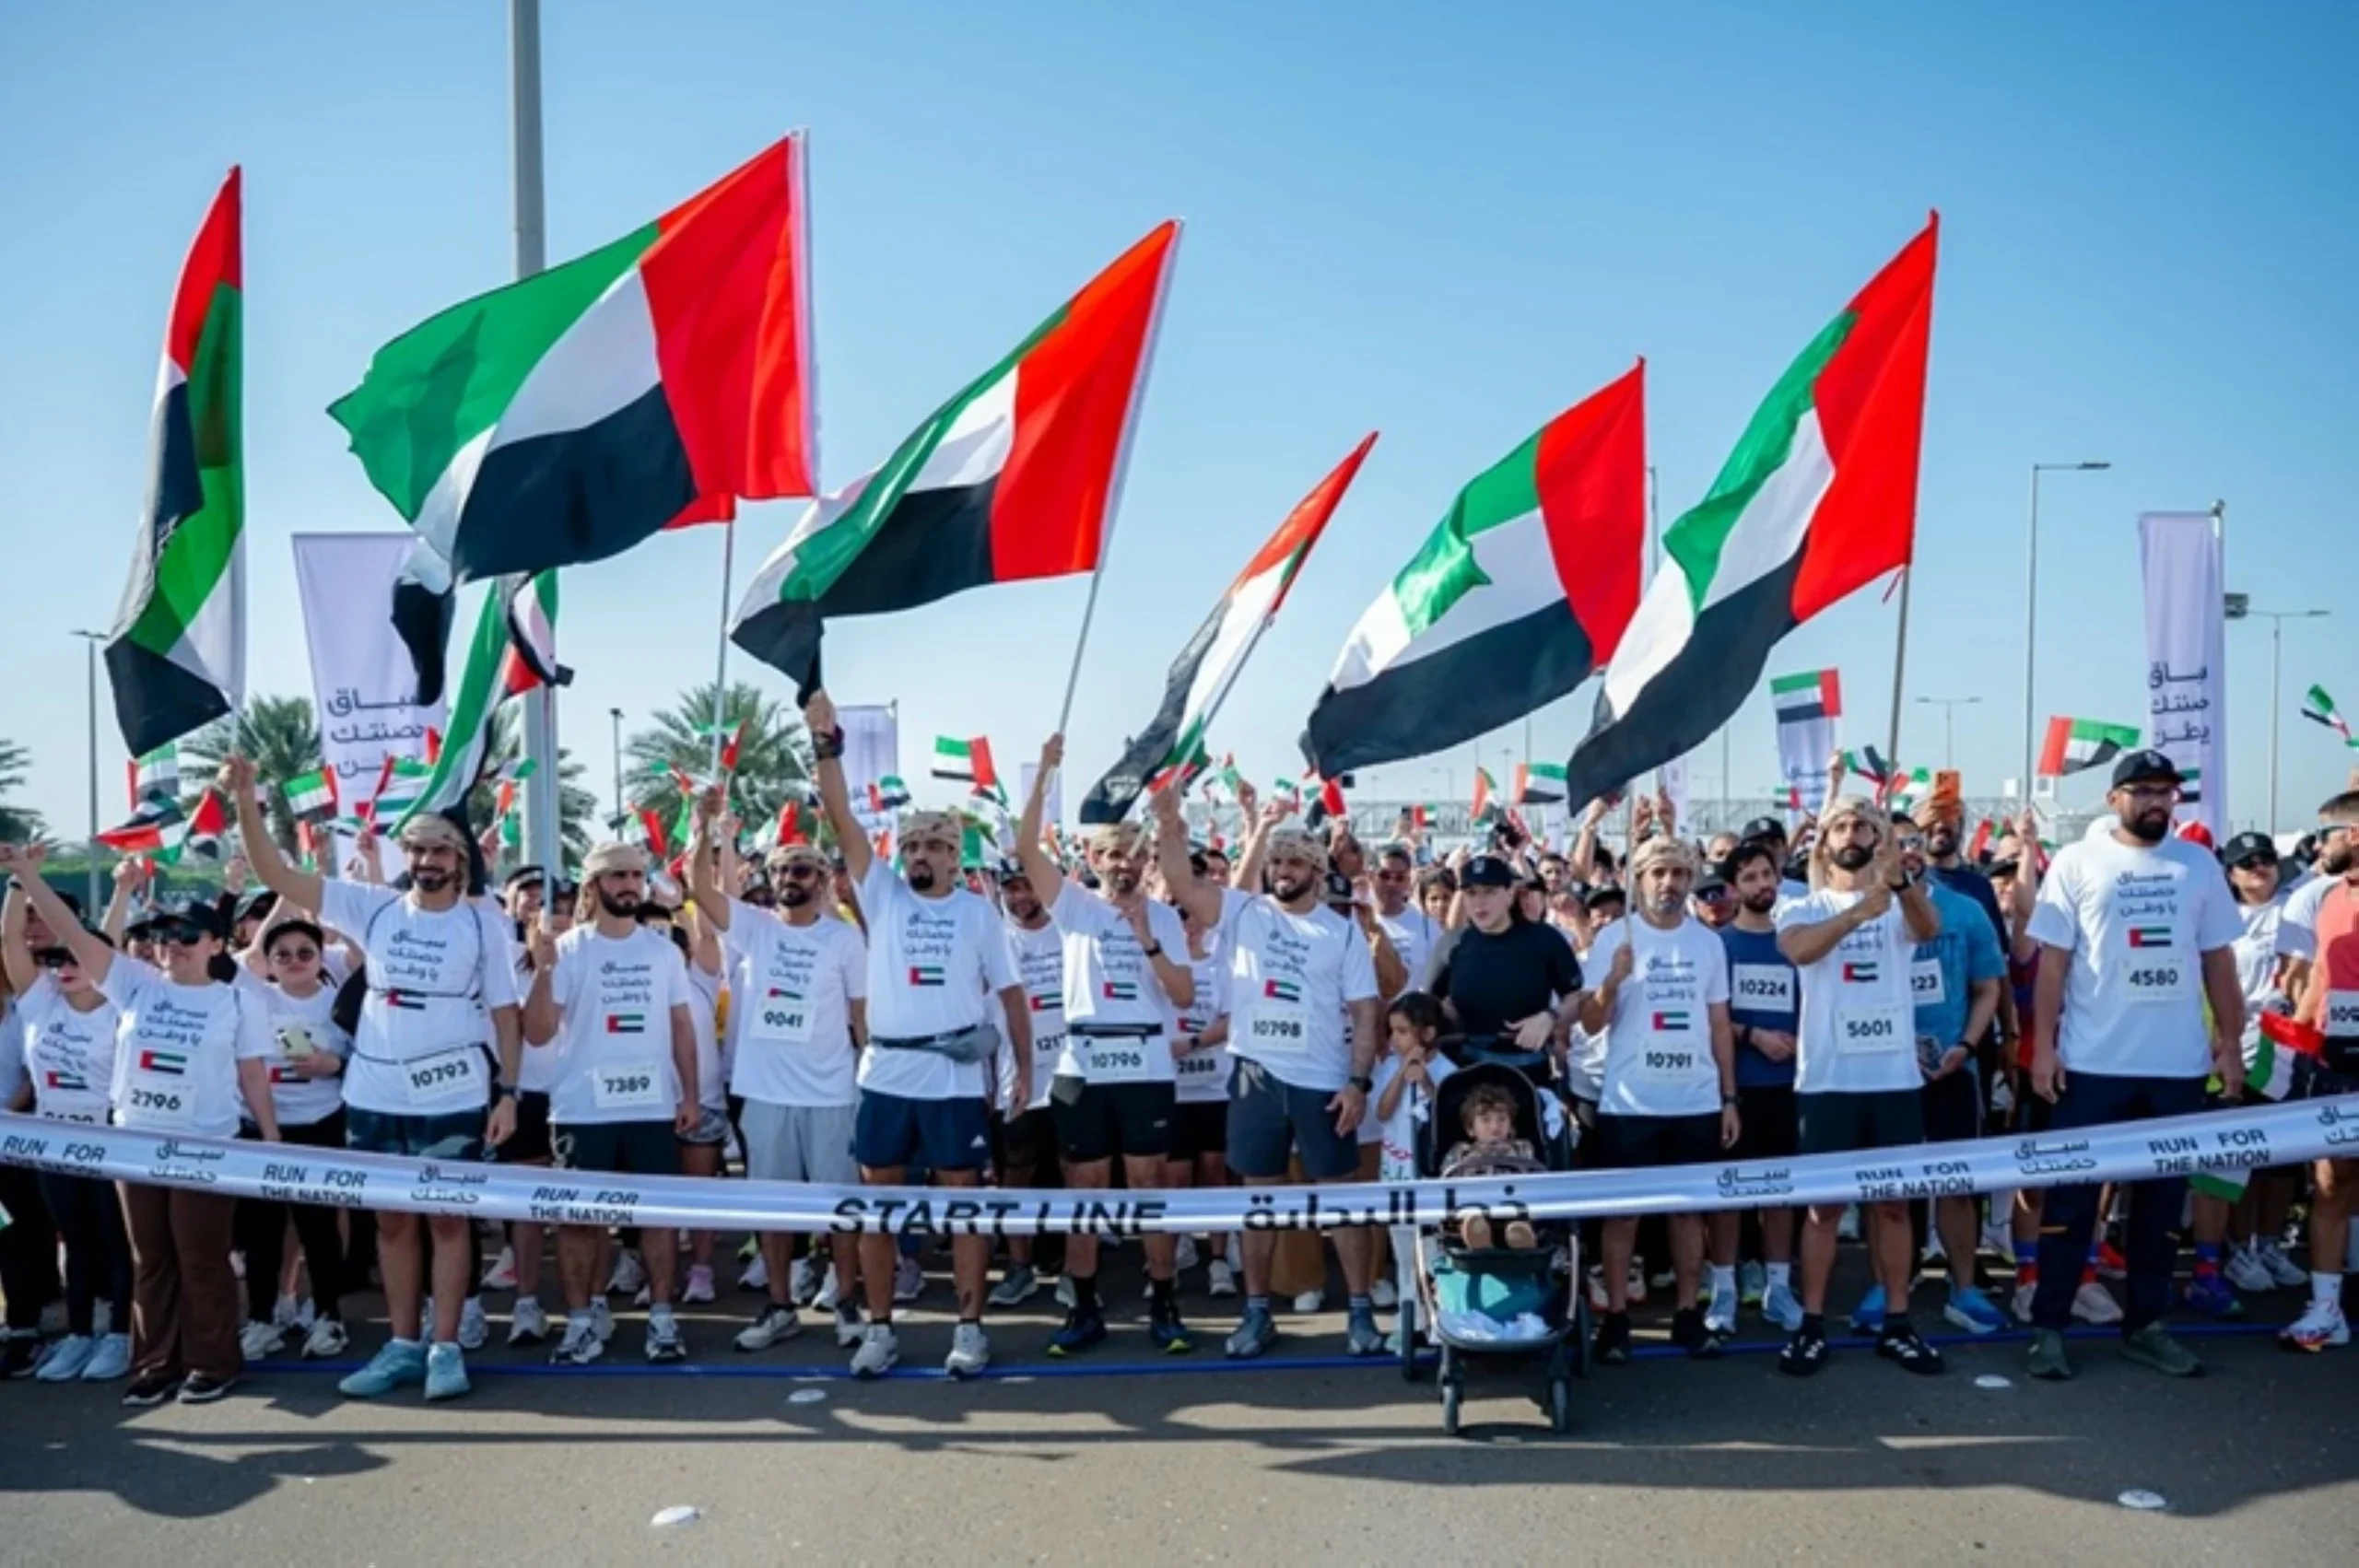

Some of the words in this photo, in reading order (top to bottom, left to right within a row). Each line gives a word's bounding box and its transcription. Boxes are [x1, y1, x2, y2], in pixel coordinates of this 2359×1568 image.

[2130, 967, 2178, 986] 4580
[1740, 978, 1787, 997] 10224
[764, 1010, 804, 1028] 9041
[1253, 1020, 1302, 1039] 10798
[1847, 1018, 1893, 1038] 5601
[1091, 1051, 1143, 1069] 10796
[1646, 1051, 1692, 1069] 10791
[411, 1060, 470, 1089] 10793
[604, 1076, 651, 1094] 7389
[131, 1088, 182, 1111] 2796
[3, 1134, 49, 1155] RUN
[62, 1142, 106, 1163] FOR
[2148, 1137, 2199, 1155] RUN
[2217, 1129, 2267, 1149] FOR
[1855, 1167, 1905, 1182] RUN
[1922, 1161, 1969, 1176] FOR
[2154, 1156, 2193, 1175] THE
[2197, 1149, 2271, 1171] NATION
[263, 1164, 309, 1183] RUN
[323, 1167, 368, 1188] FOR
[261, 1185, 292, 1199] THE
[298, 1186, 363, 1206] NATION
[532, 1186, 580, 1202] RUN
[594, 1189, 640, 1208] FOR
[1858, 1183, 1895, 1199] THE
[1902, 1176, 1975, 1198] NATION
[530, 1204, 564, 1222] THE
[569, 1206, 634, 1224] NATION
[829, 1197, 1020, 1236] START
[1034, 1199, 1168, 1235] LINE
